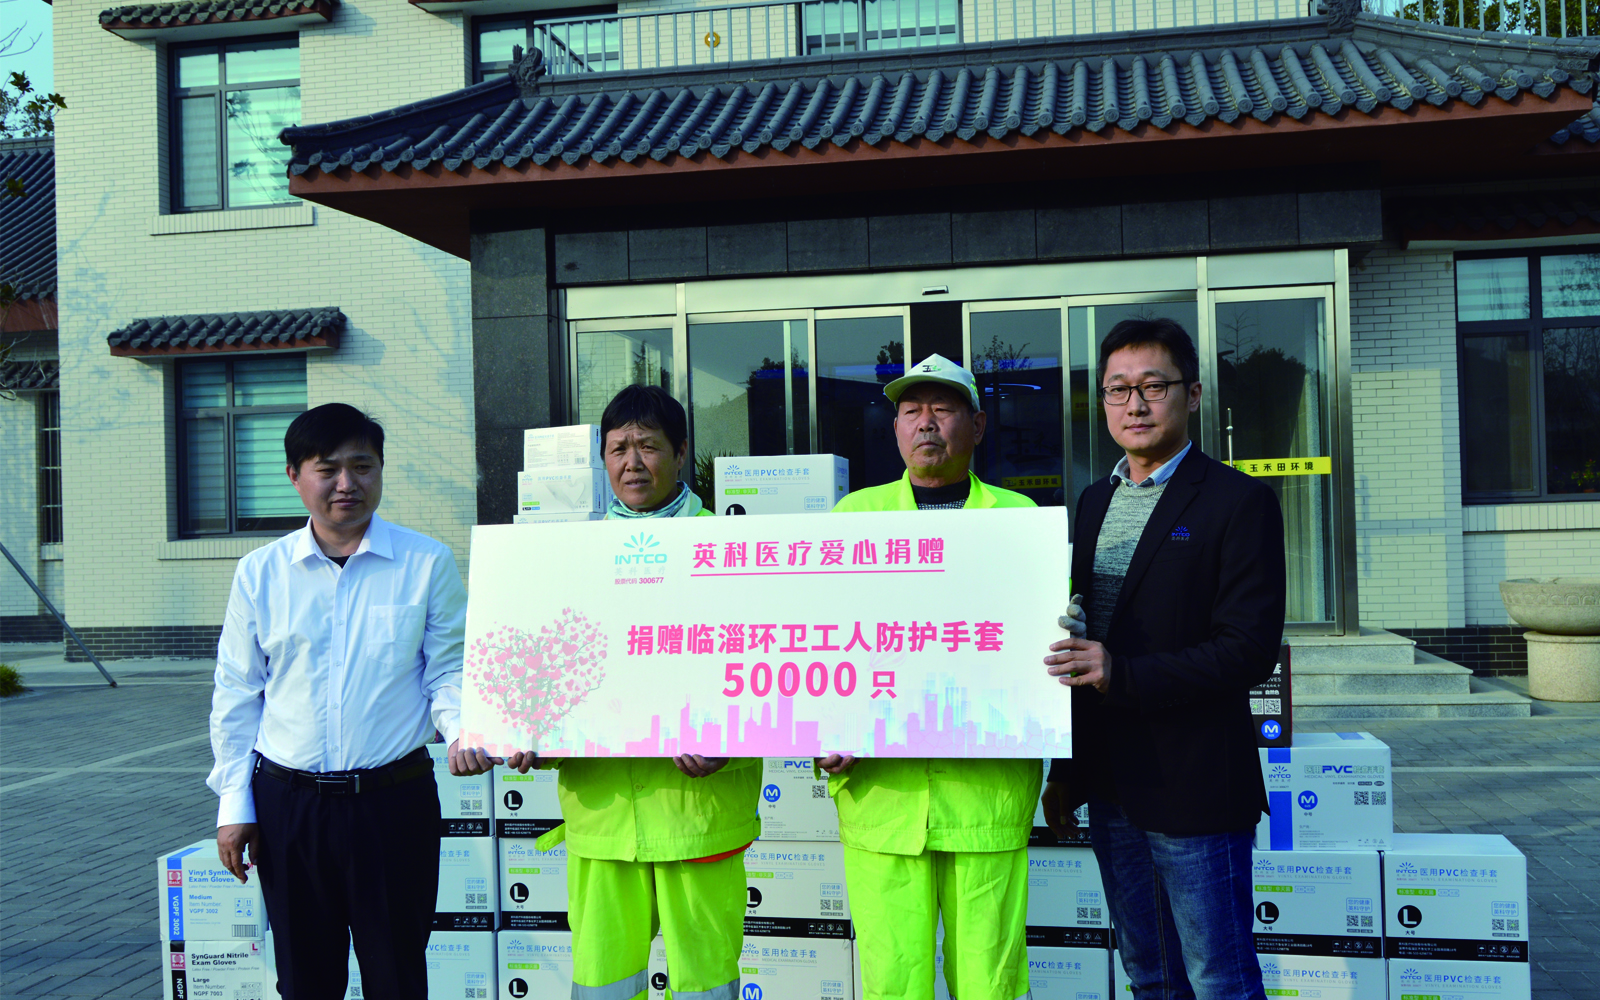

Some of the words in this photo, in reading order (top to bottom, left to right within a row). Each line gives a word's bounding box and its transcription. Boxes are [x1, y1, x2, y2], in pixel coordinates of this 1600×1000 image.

[745, 468, 810, 477] 医用PVC检查手套
[1250, 462, 1314, 472] 玉禾田环境
[692, 537, 945, 568] 英科医疗爱心捐赠
[615, 553, 668, 565] INTCO
[626, 620, 1004, 656] 捐赠临淄环卫工人防护手套
[870, 670, 898, 699] 只
[1265, 725, 1278, 733] M
[508, 794, 519, 807] L
[760, 853, 825, 861] 医用PVC检查手套
[1030, 860, 1082, 868] PVC检查手套
[1277, 865, 1352, 875] 医用PVC检查手套
[1420, 868, 1497, 877] 医用PVC检查手套
[514, 886, 525, 900] L
[747, 890, 758, 905] L
[1261, 905, 1274, 920] L
[1403, 909, 1417, 924] L
[762, 948, 817, 958] 医用检查手套
[1029, 961, 1081, 970] PVC检查手套
[1283, 969, 1357, 979] 医用PVC检查手套
[1424, 974, 1501, 984] 医用PVC检查手套
[512, 981, 524, 995] L
[745, 988, 759, 1000] M
